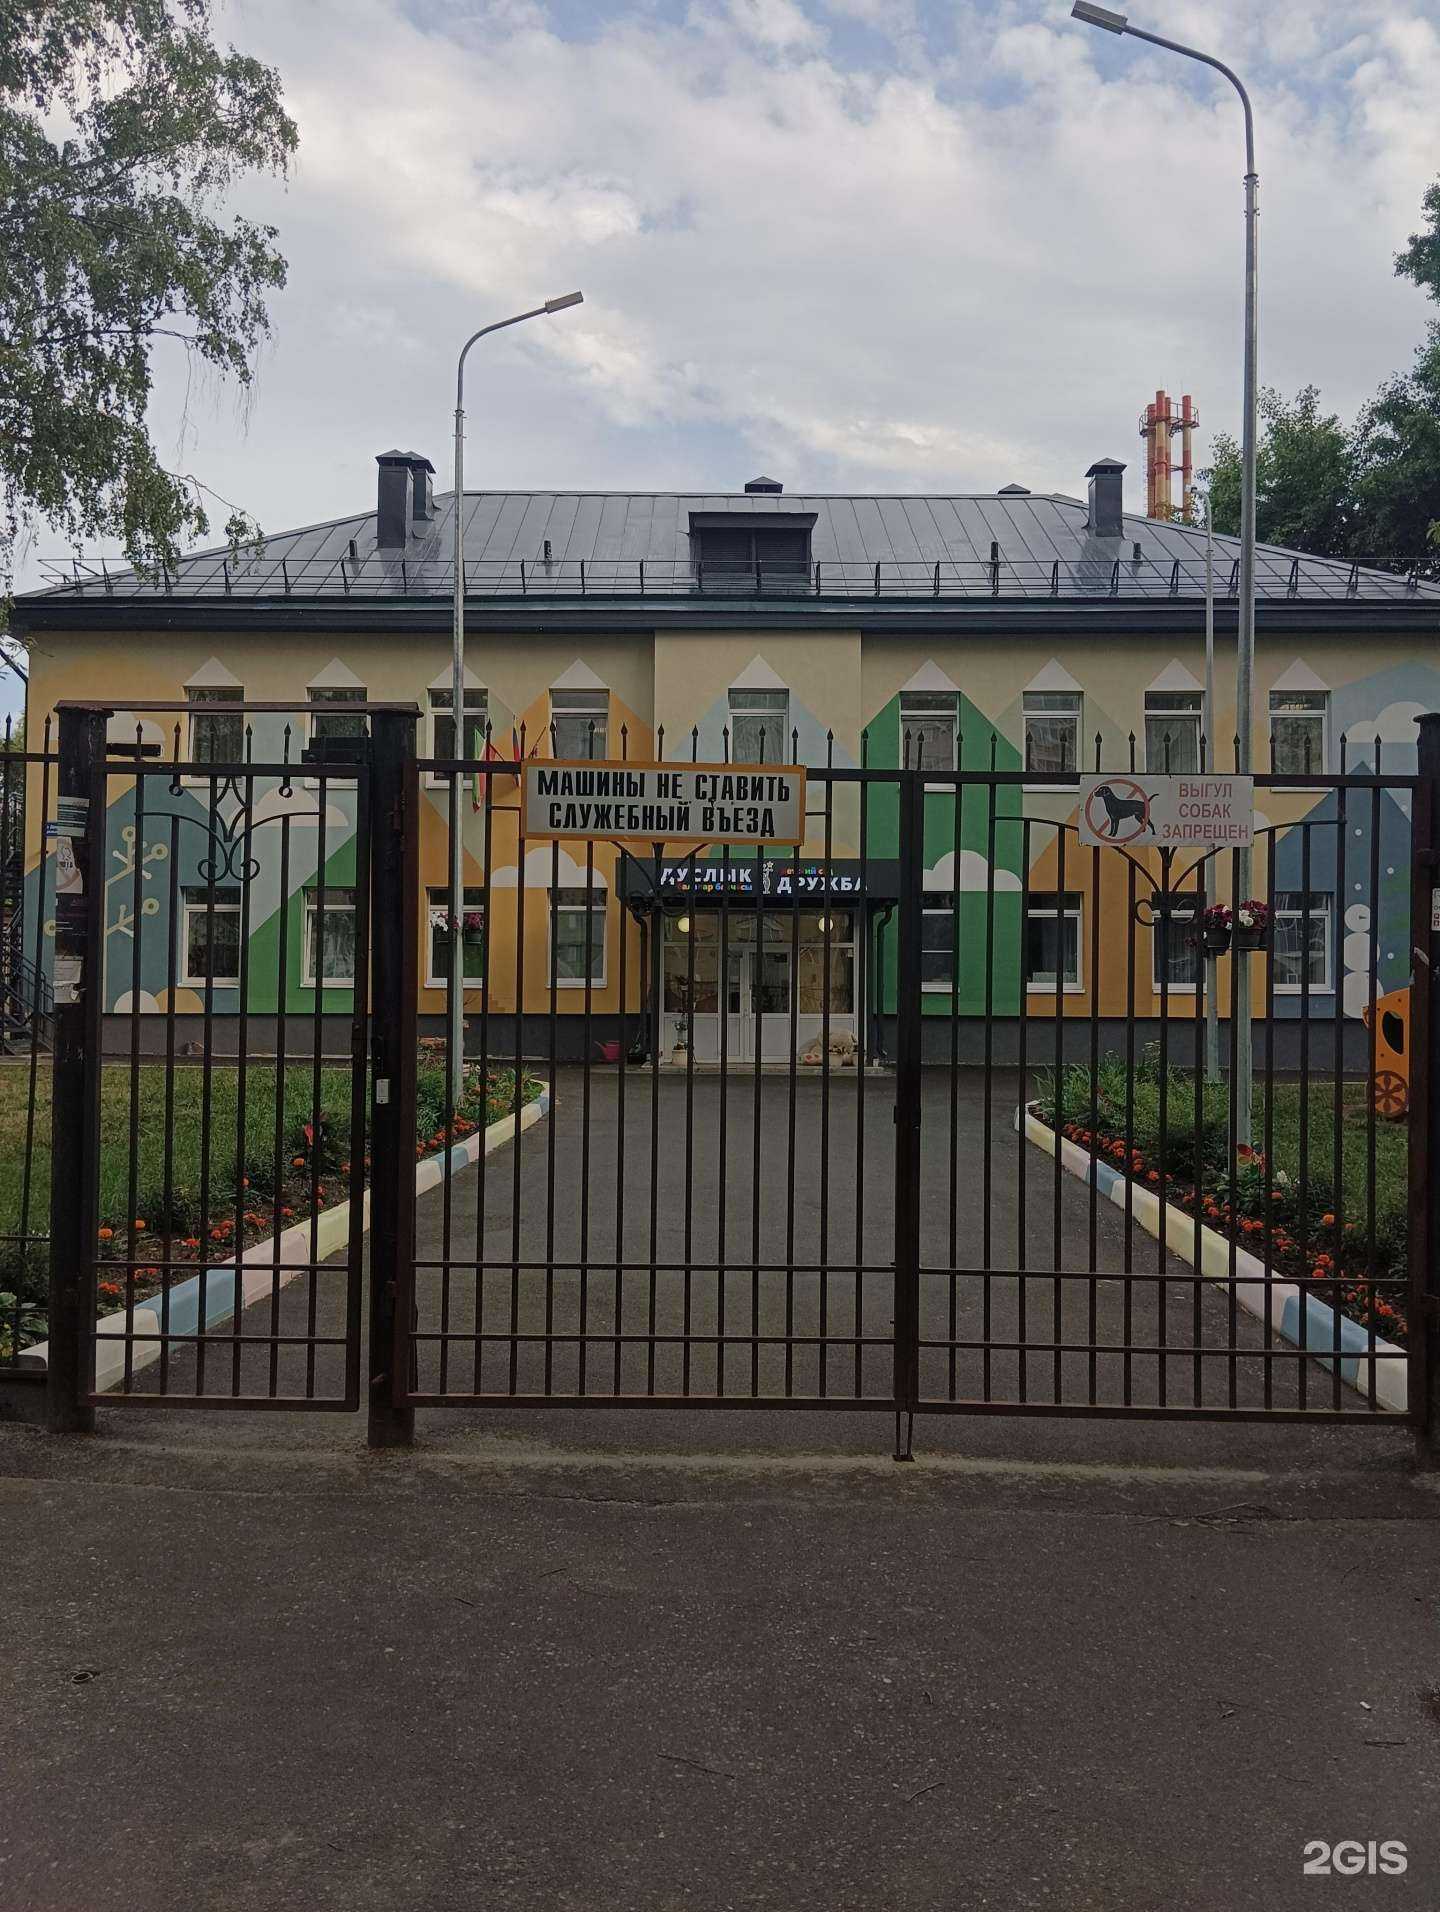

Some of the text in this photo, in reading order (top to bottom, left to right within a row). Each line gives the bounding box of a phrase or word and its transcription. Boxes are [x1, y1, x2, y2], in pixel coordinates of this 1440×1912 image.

[538, 770, 790, 802] МАШИНЫ НЕ СТАВИТЬ
[1179, 783, 1232, 798] ВЫГУЛ
[549, 801, 775, 838] СЛУЖЕБНЫЙ ВЪЕЗД
[1179, 803, 1231, 819] СОБАК
[1162, 823, 1248, 841] ЗАПРЕЩЕН
